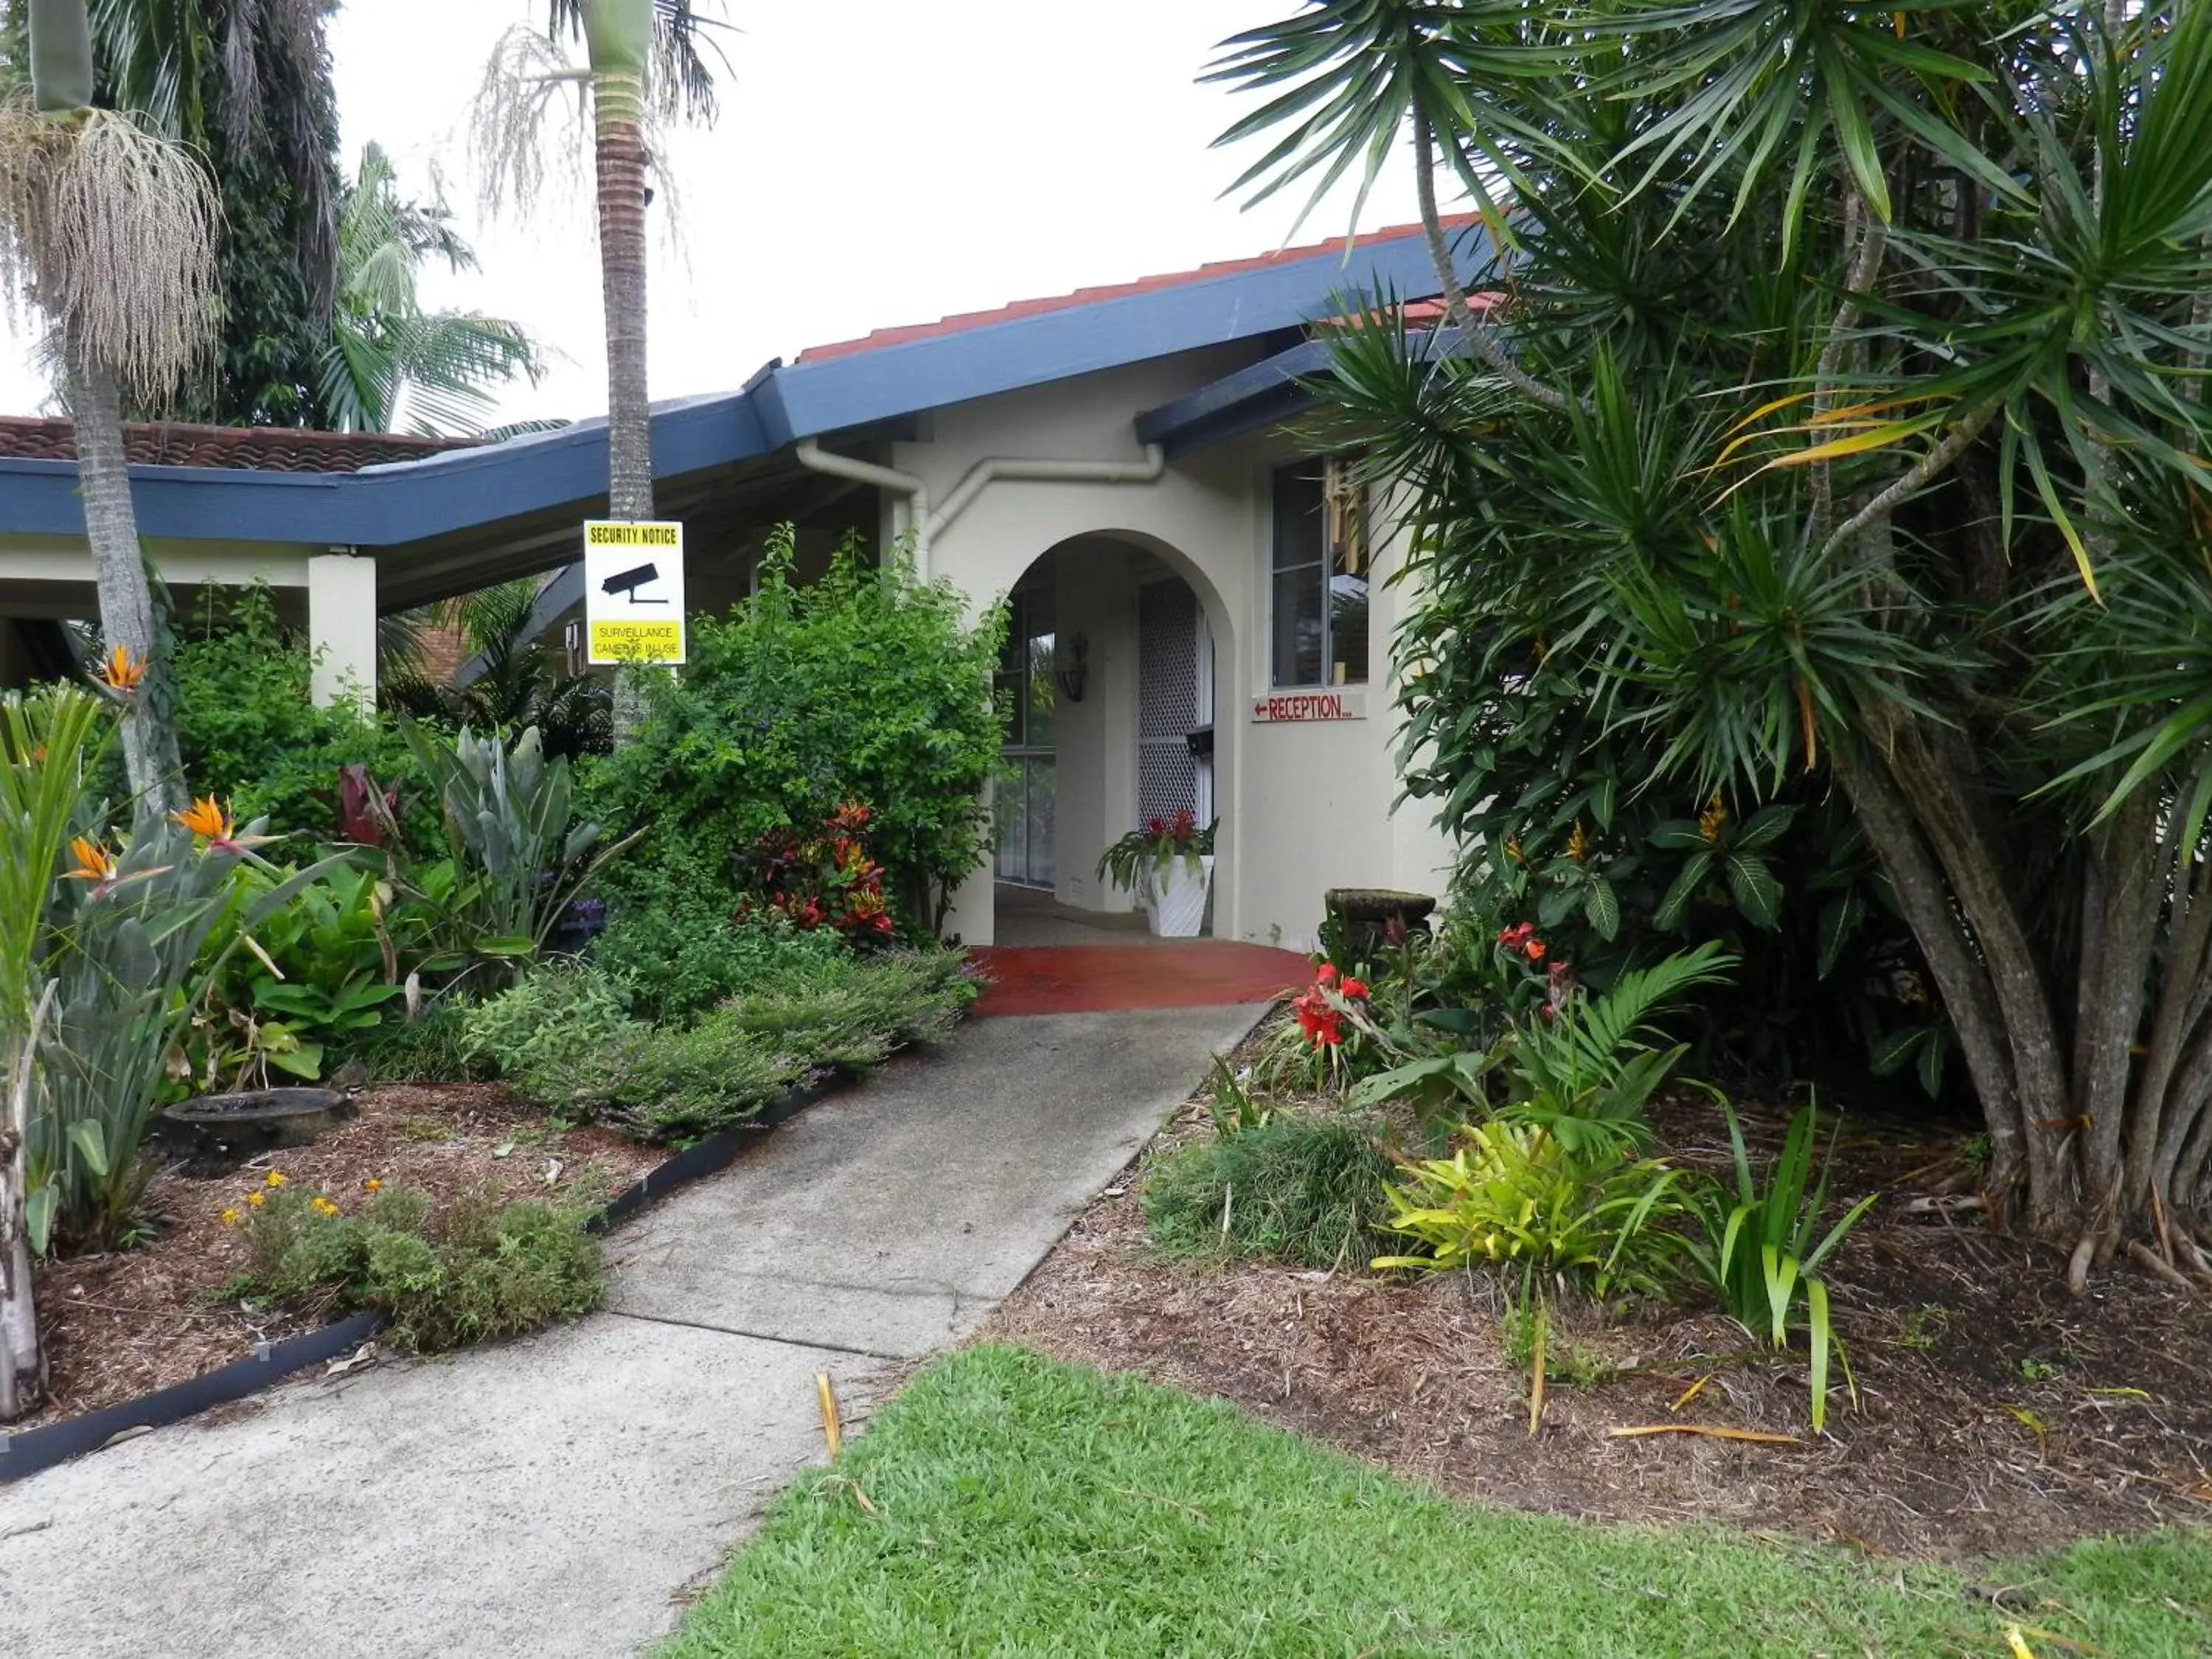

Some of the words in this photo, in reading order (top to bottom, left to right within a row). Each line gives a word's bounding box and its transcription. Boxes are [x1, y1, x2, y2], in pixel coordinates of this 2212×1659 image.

[591, 527, 638, 543] SECURITY
[642, 528, 676, 544] NOTICE
[599, 627, 672, 638] SURVEILLANCE
